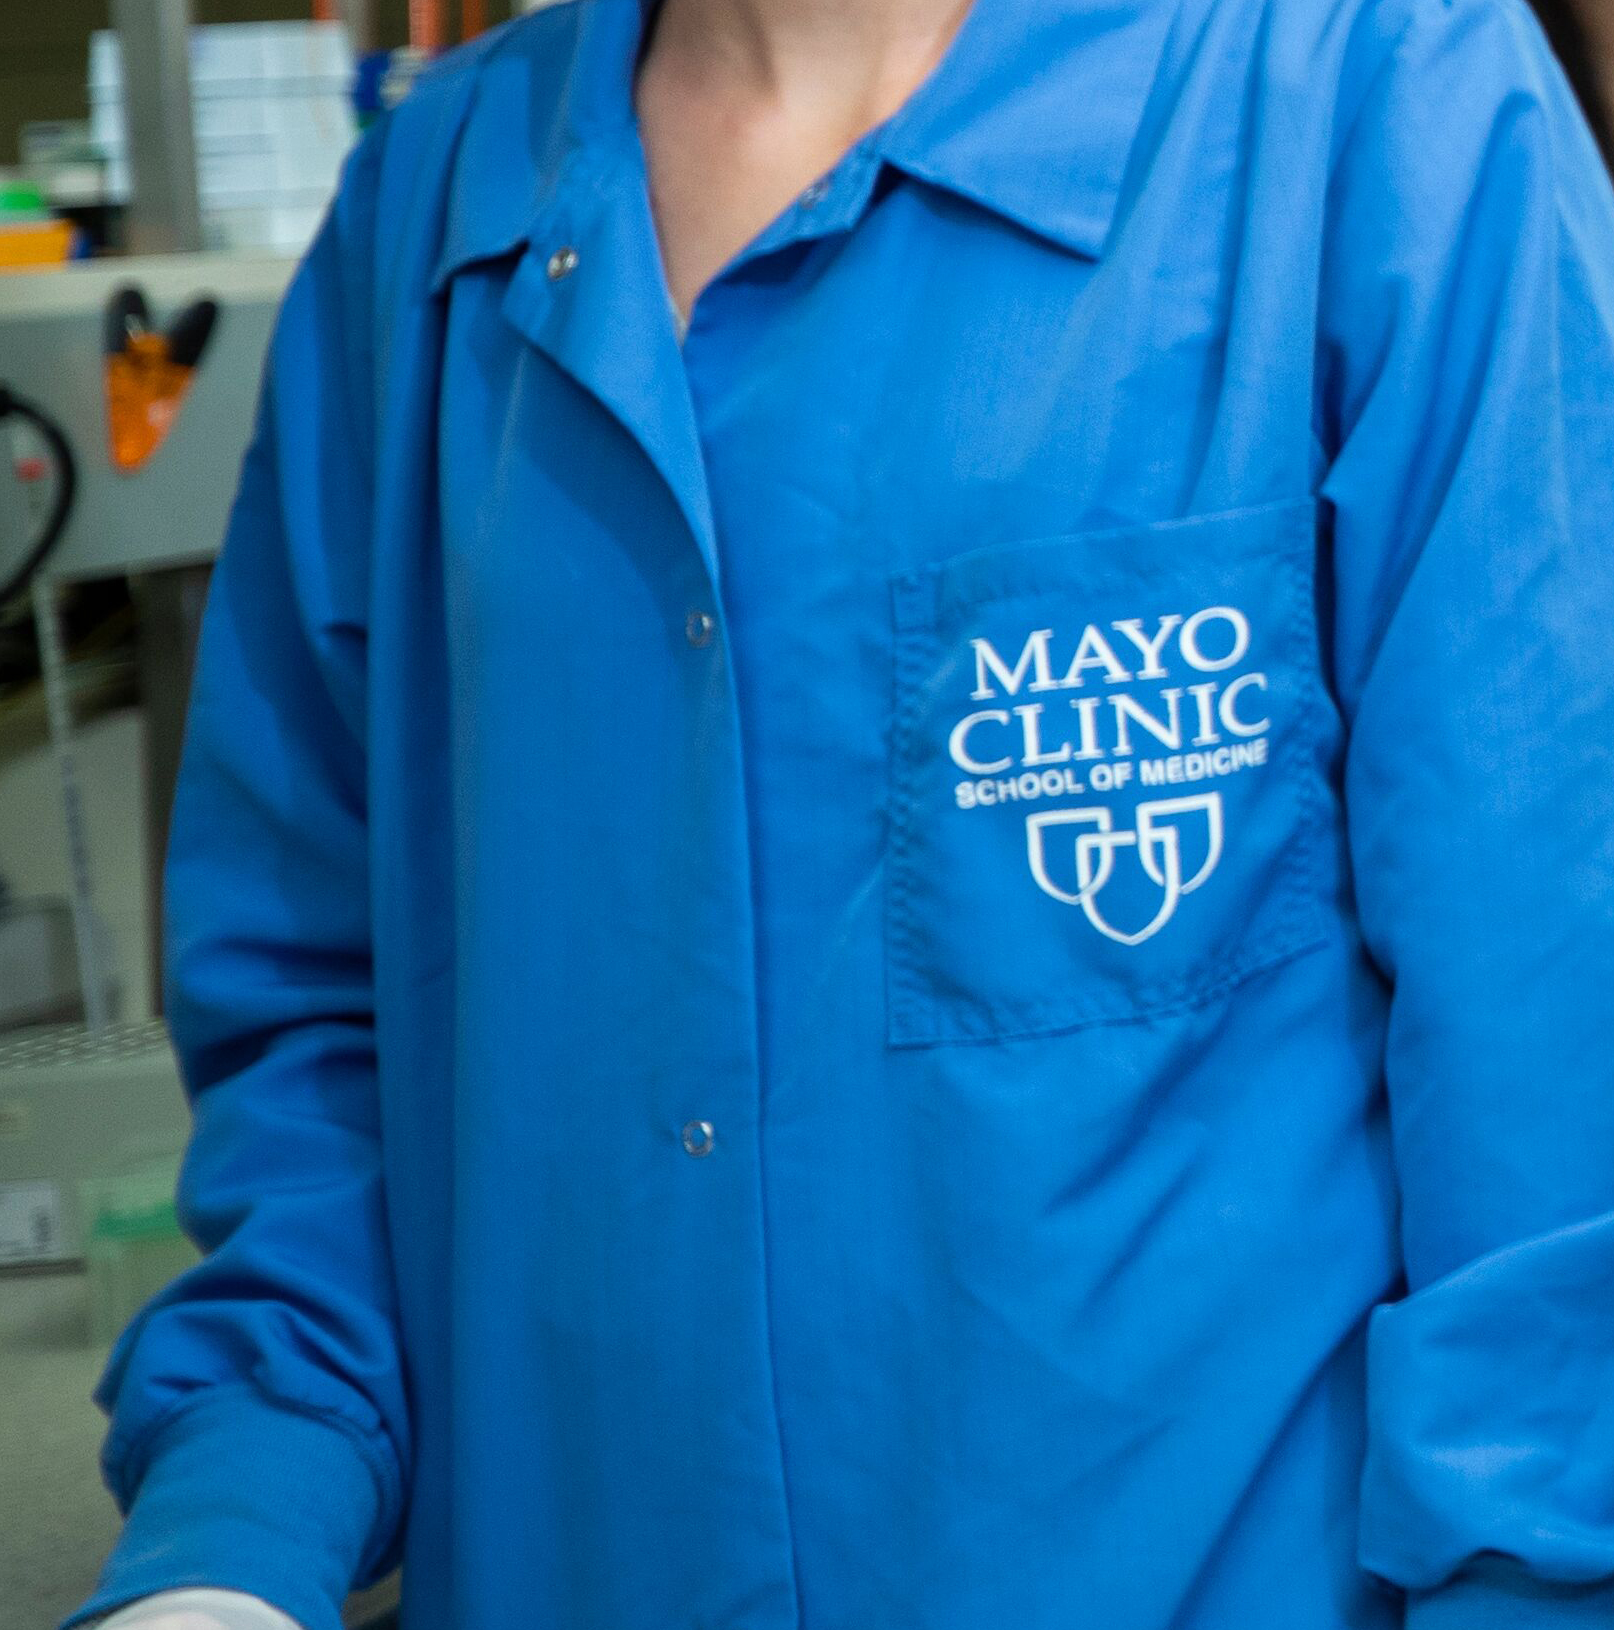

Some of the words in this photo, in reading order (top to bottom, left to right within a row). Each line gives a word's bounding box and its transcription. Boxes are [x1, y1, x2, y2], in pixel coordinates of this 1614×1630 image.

[969, 606, 1251, 701] MAYO
[949, 672, 1271, 775] CLINIC
[954, 768, 1085, 810] SCHOOL
[1089, 761, 1133, 792] OF
[1139, 737, 1269, 787] MEDICINE
